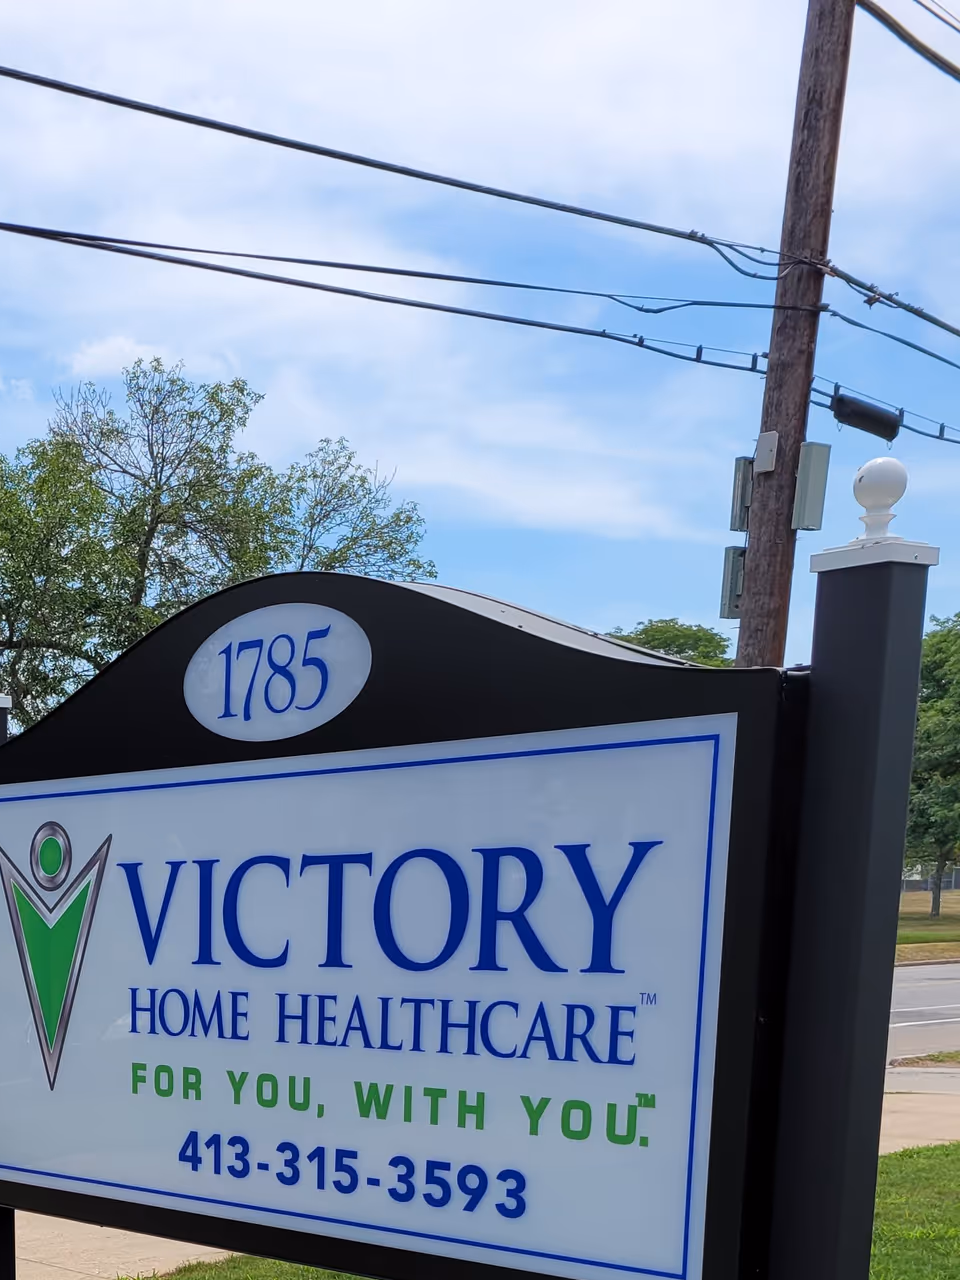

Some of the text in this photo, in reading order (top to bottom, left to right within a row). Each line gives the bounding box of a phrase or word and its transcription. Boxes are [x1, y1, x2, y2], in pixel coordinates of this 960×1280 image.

[216, 623, 334, 722] 1785
[115, 839, 665, 976] VICTORY
[128, 987, 250, 1042] HOME
[274, 992, 638, 1067] HEALTHCARE
[131, 1062, 202, 1101] FOR
[227, 1071, 325, 1118] YOU,
[354, 1080, 486, 1130] WITH
[178, 1129, 530, 1220] 413-315-3593
